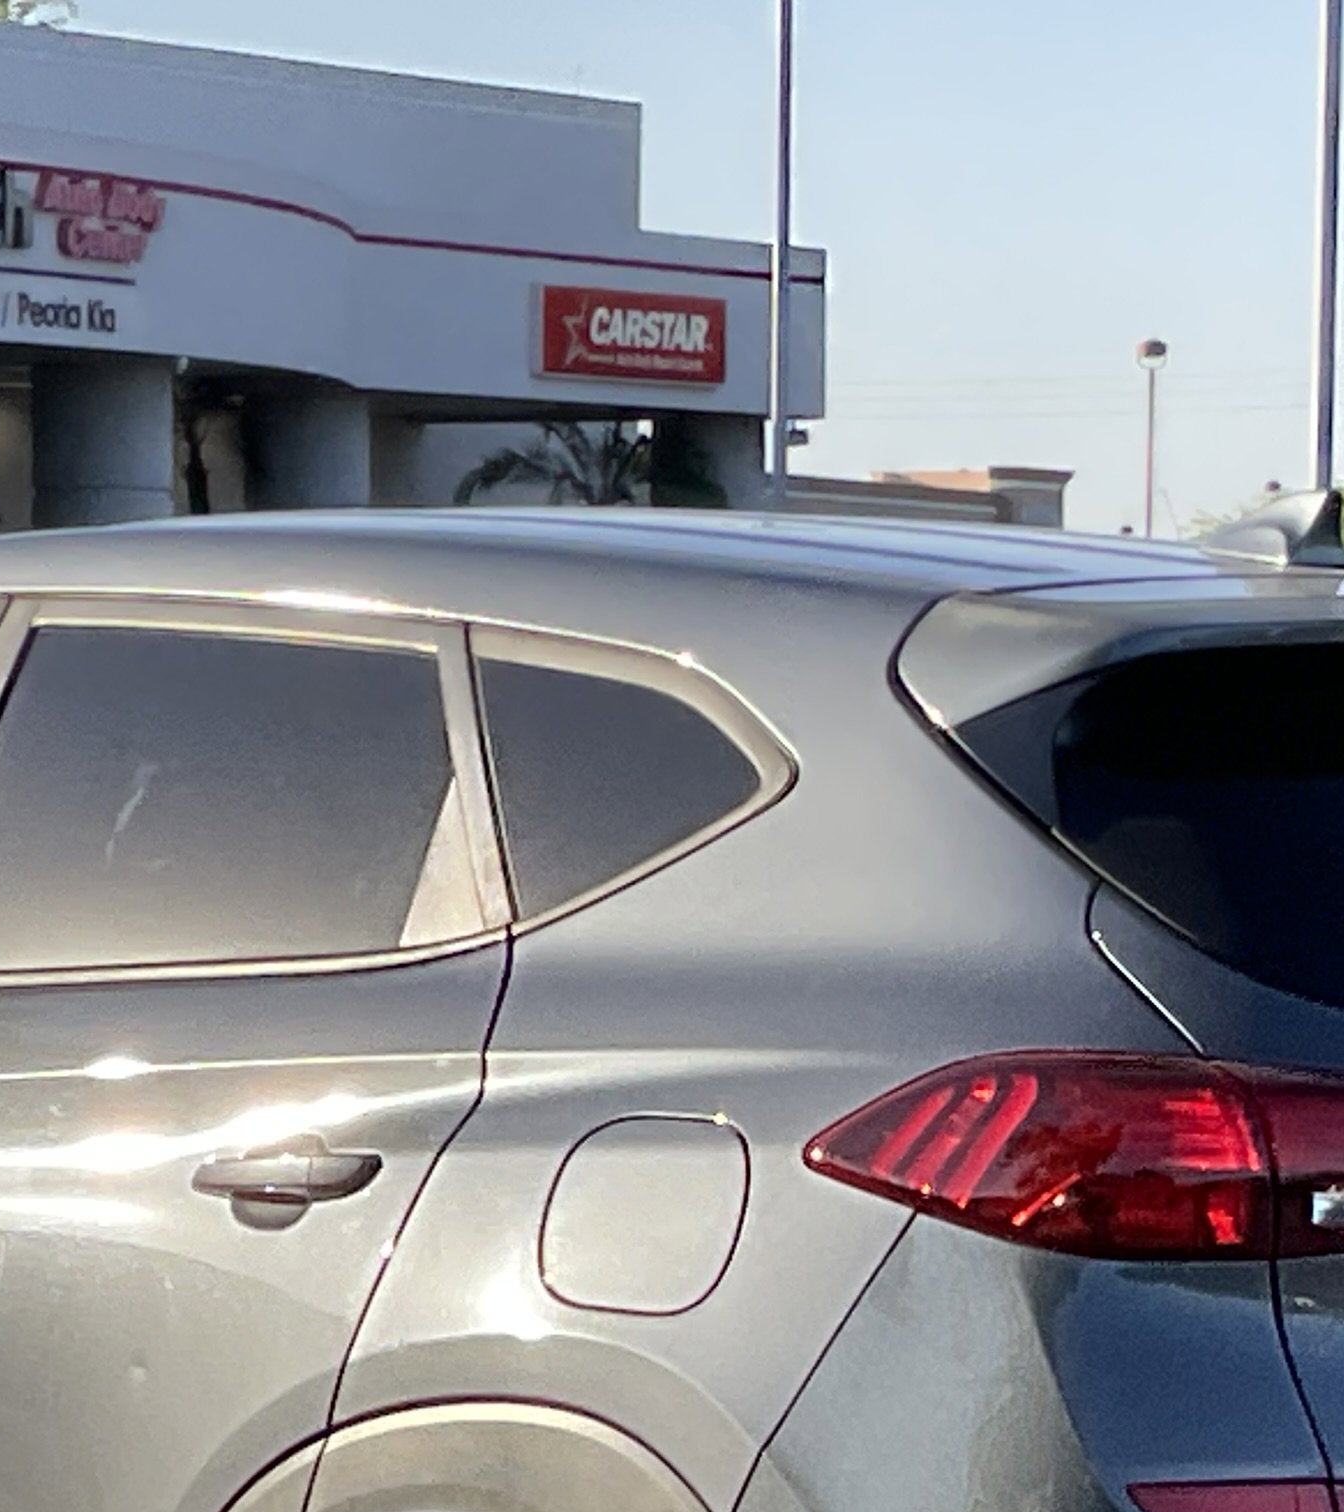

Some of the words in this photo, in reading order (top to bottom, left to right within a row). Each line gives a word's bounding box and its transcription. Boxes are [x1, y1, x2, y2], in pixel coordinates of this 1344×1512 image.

[17, 291, 81, 330] Peoria
[87, 298, 116, 332] Kia
[589, 306, 709, 352] CARSTAR
